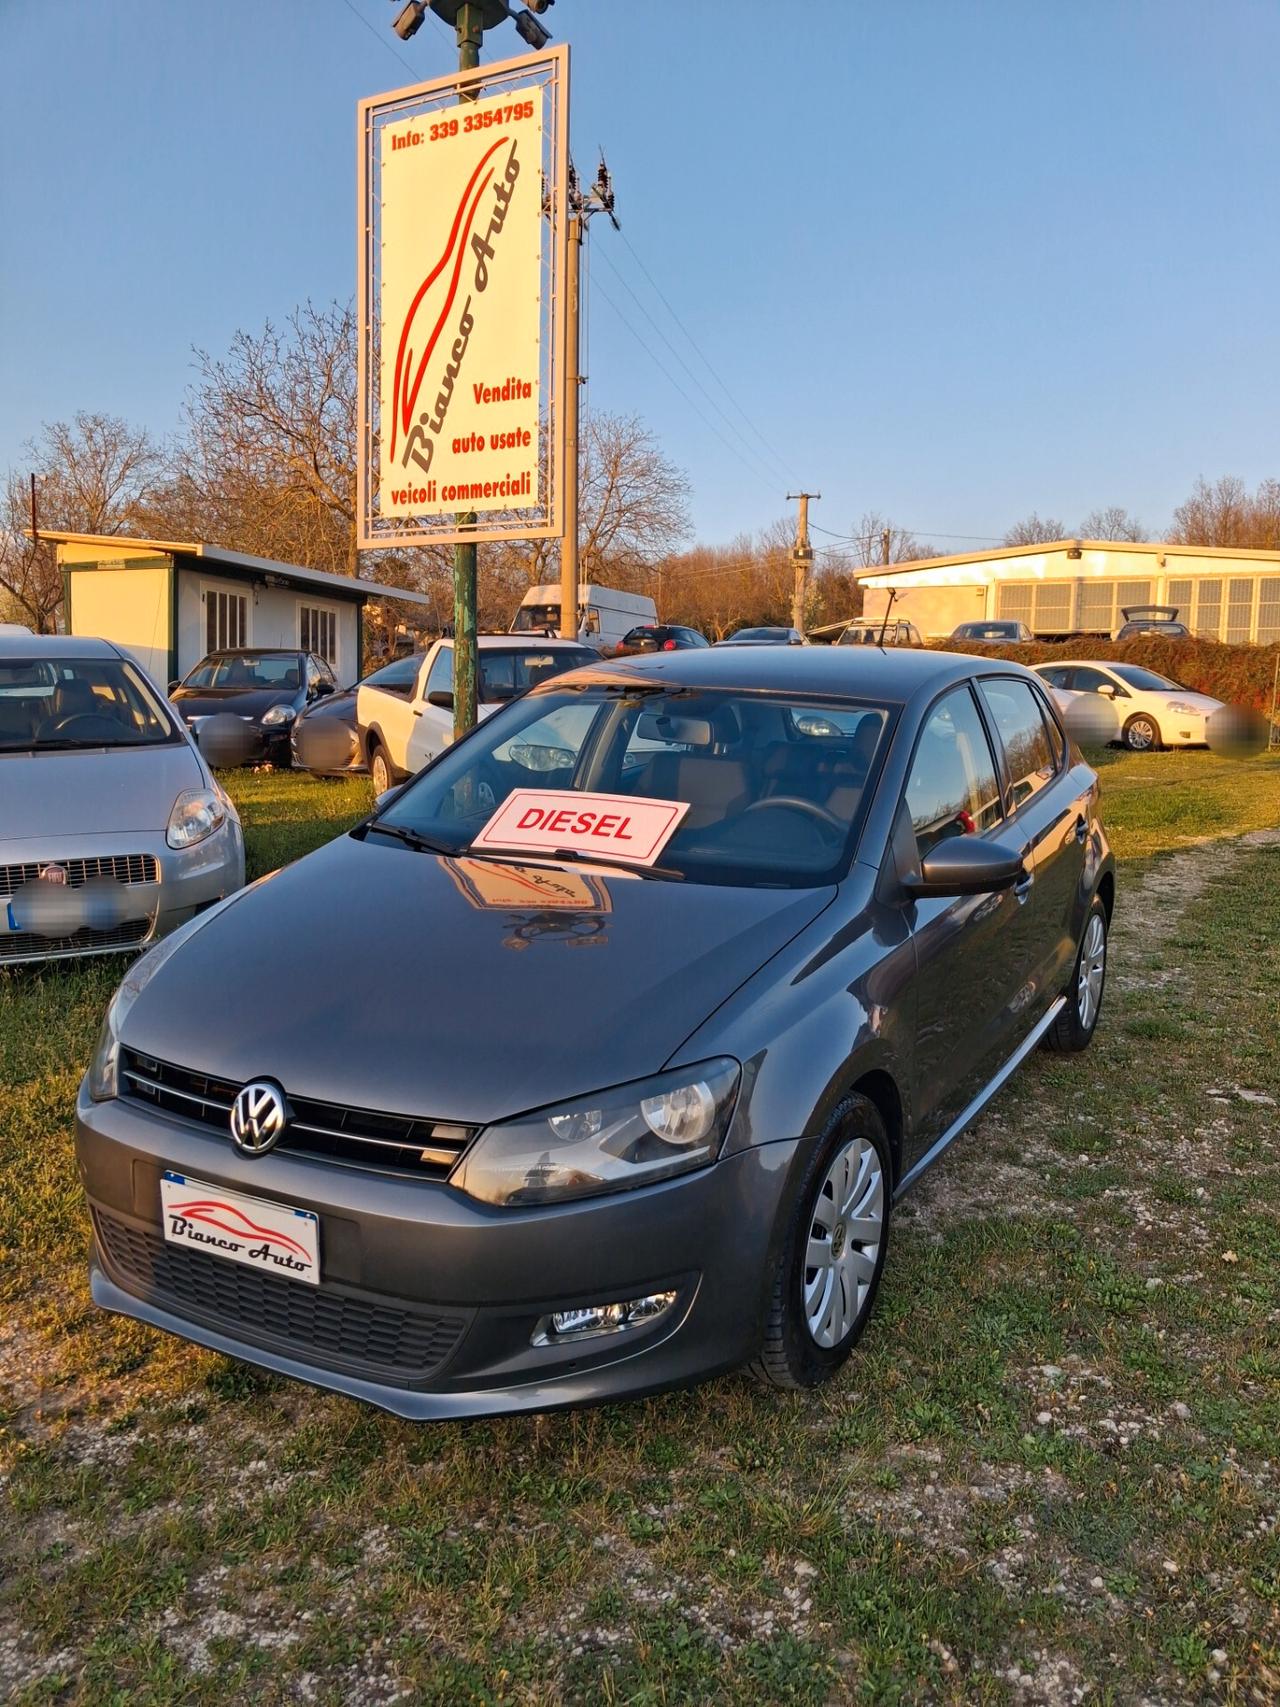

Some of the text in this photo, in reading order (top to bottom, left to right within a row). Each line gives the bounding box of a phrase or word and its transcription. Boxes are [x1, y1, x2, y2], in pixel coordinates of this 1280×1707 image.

[391, 100, 534, 151] Info: 339 3354795
[402, 138, 520, 474] Bianco Auto
[473, 377, 532, 404] Vendita
[452, 427, 532, 454] auto usate
[391, 471, 531, 505] veicoli commerciali
[516, 808, 633, 840] DIESEL
[169, 1215, 312, 1271] Bianco Auto
